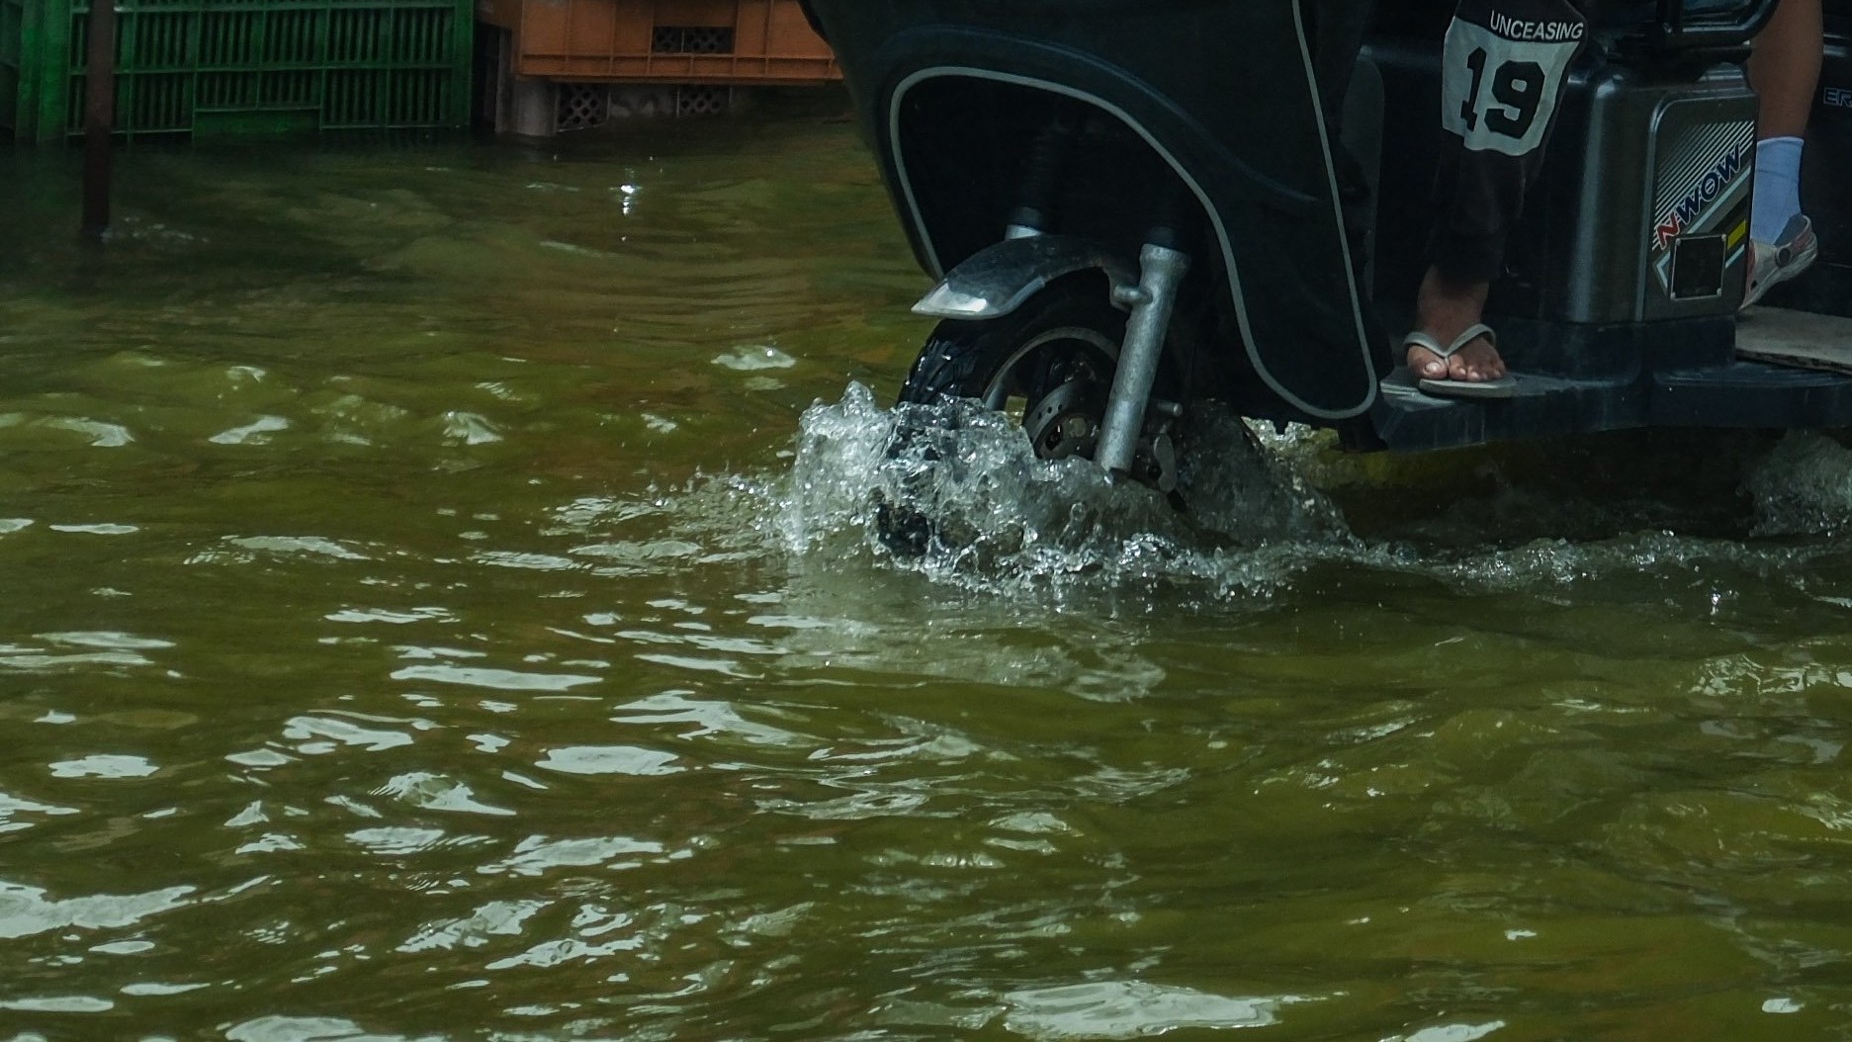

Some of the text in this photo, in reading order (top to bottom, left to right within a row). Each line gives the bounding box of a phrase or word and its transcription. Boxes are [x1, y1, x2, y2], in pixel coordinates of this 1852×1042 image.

[1489, 9, 1584, 41] UNCEASING
[1460, 46, 1546, 139] 19
[1655, 140, 1741, 251] NWOW
